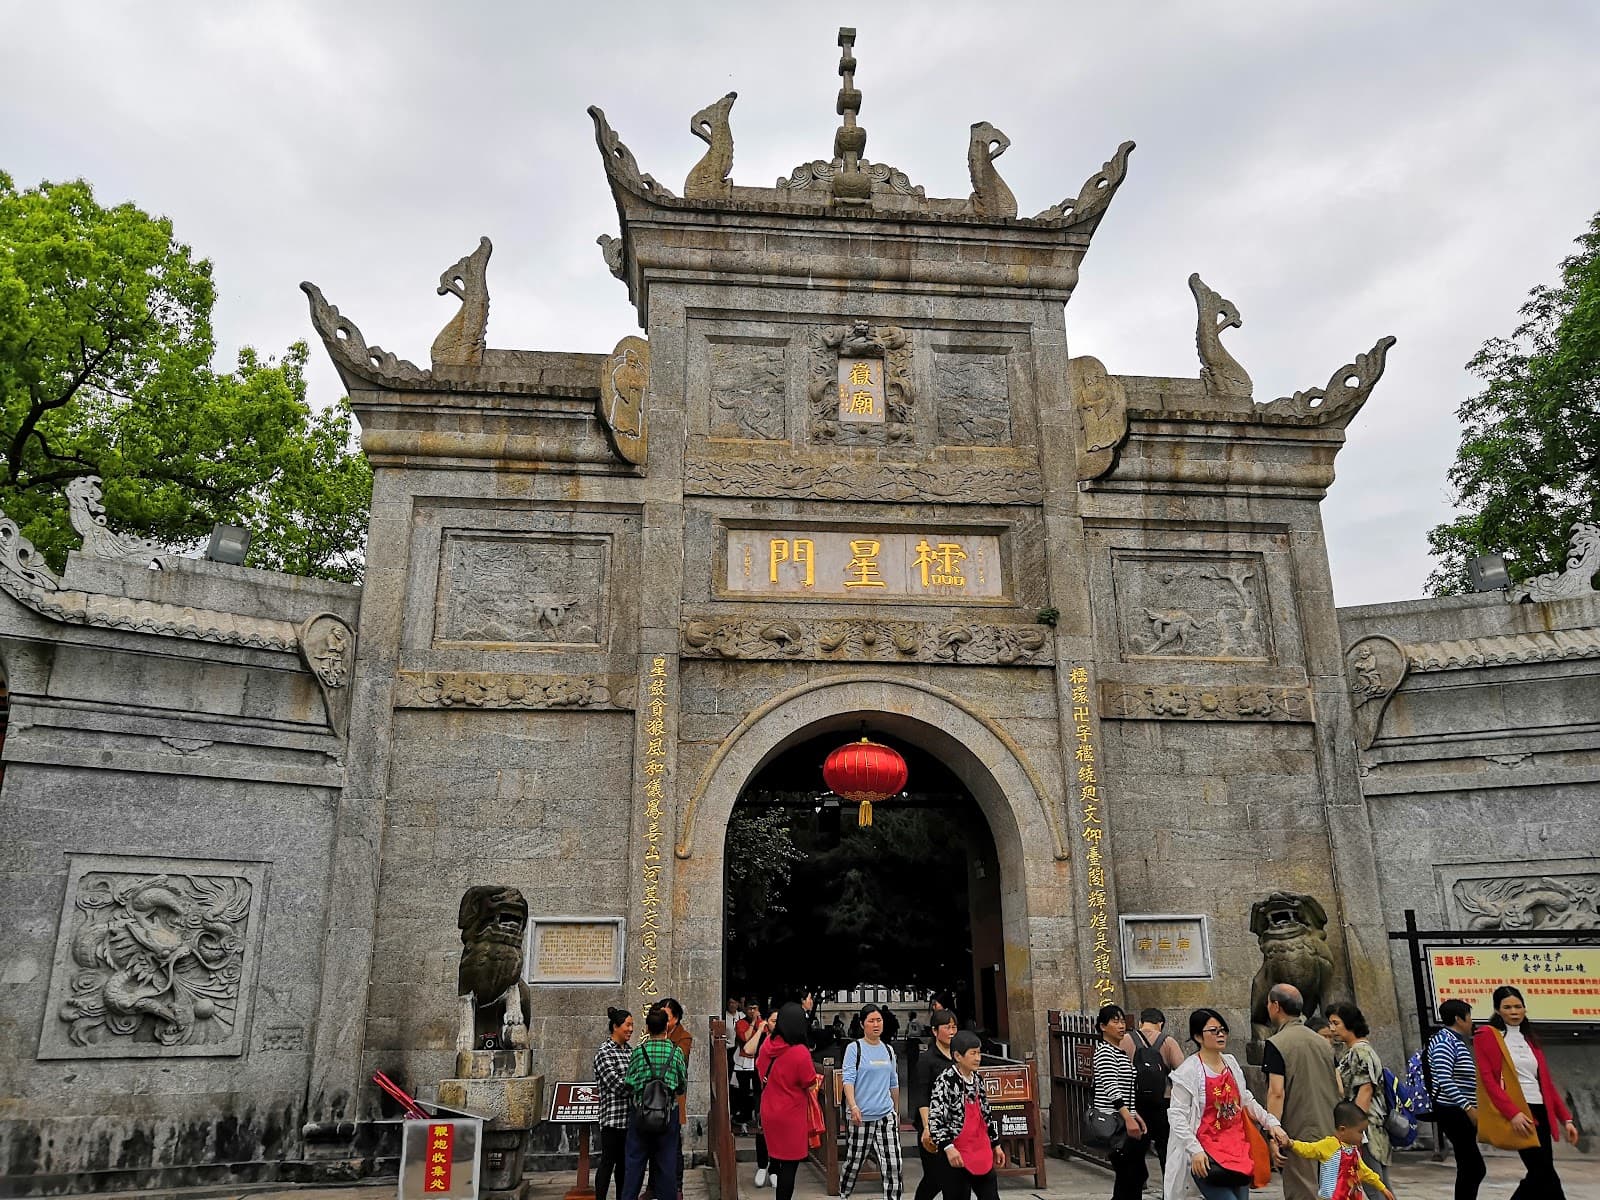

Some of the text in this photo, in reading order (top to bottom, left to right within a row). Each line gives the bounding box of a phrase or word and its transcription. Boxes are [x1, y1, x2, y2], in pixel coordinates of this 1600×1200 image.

[1004, 1079, 1024, 1089] 入口
[430, 1126, 449, 1190] 鞭炮收集处
